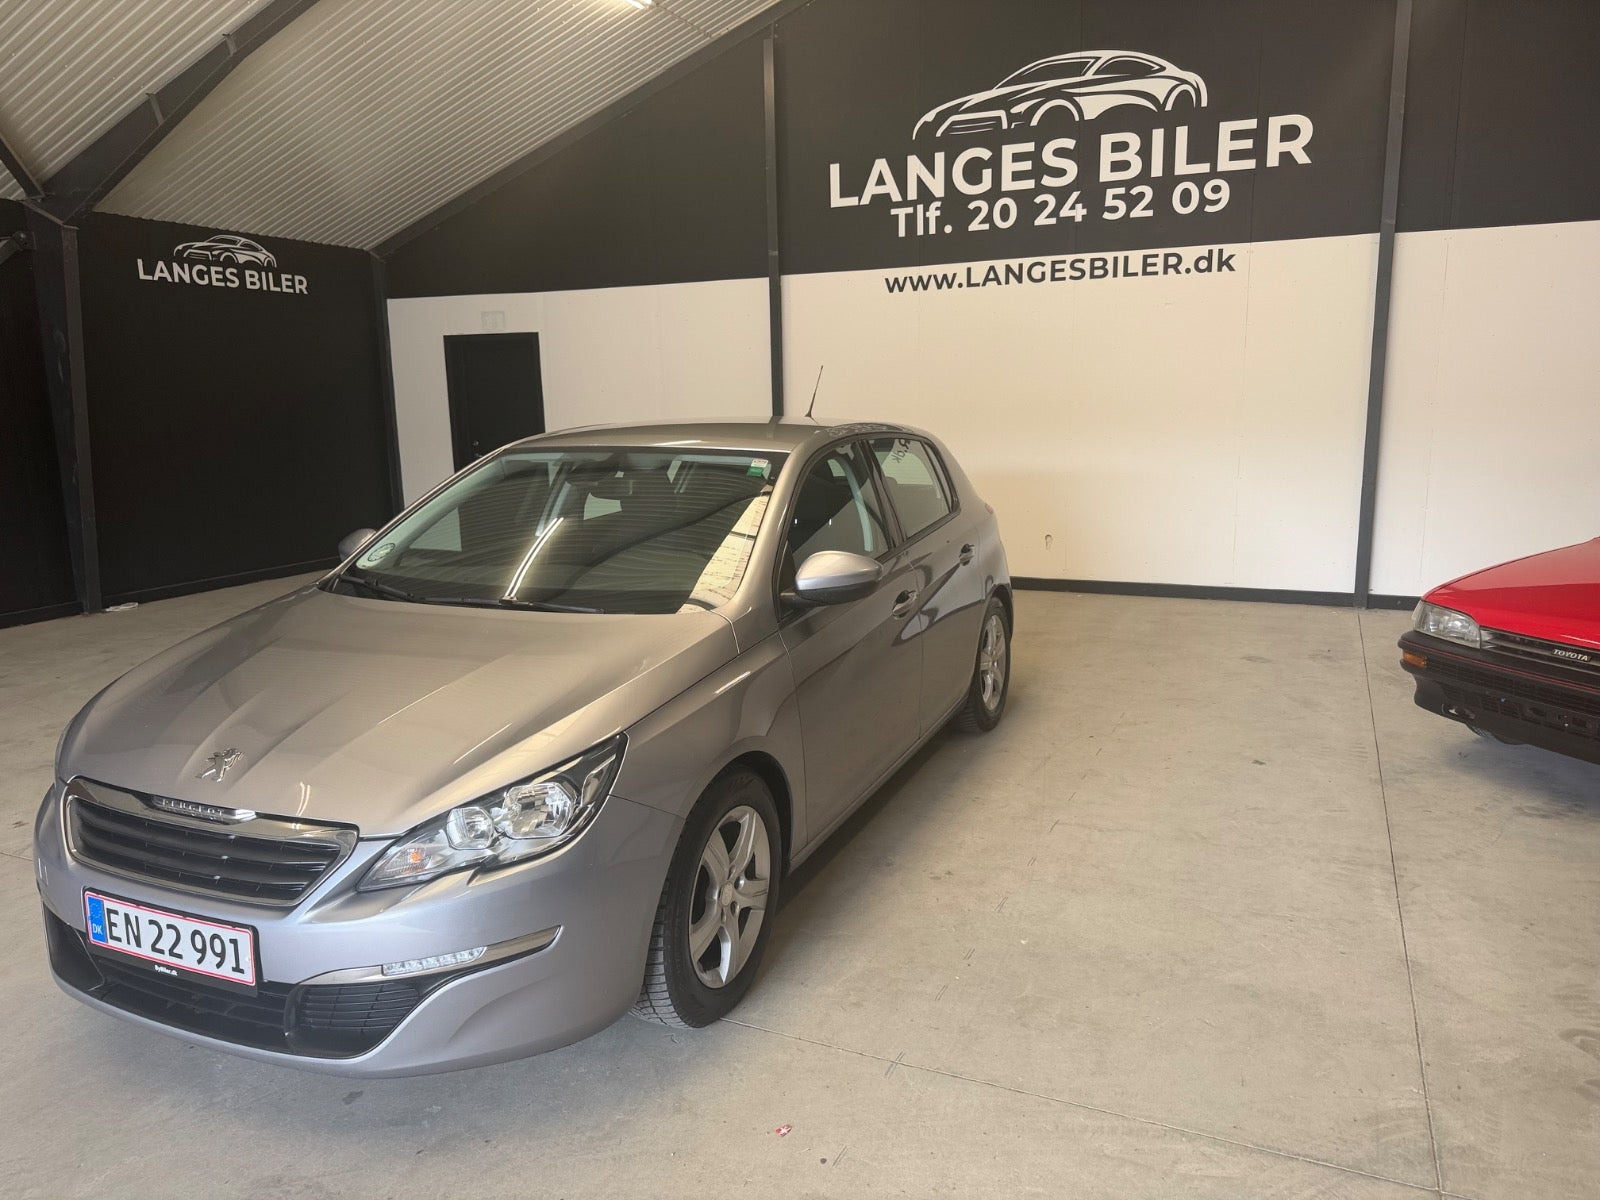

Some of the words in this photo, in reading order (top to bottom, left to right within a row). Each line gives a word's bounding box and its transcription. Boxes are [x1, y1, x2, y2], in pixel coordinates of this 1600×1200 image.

[830, 138, 1078, 208] LANGES
[1100, 114, 1313, 183] BILER
[891, 201, 952, 237] Tlf.
[968, 198, 1018, 231] 20
[1034, 191, 1088, 225] 24
[1103, 185, 1154, 220] 52
[1172, 179, 1230, 214] 09
[136, 258, 240, 288] LANGES
[245, 270, 308, 295] BILER
[885, 248, 1235, 293] www.LANGESBILER.dk
[1553, 649, 1588, 661] TOYOTA
[92, 923, 103, 935] DK
[106, 907, 142, 948] EN
[148, 919, 183, 959] 22
[190, 929, 245, 974] 991
